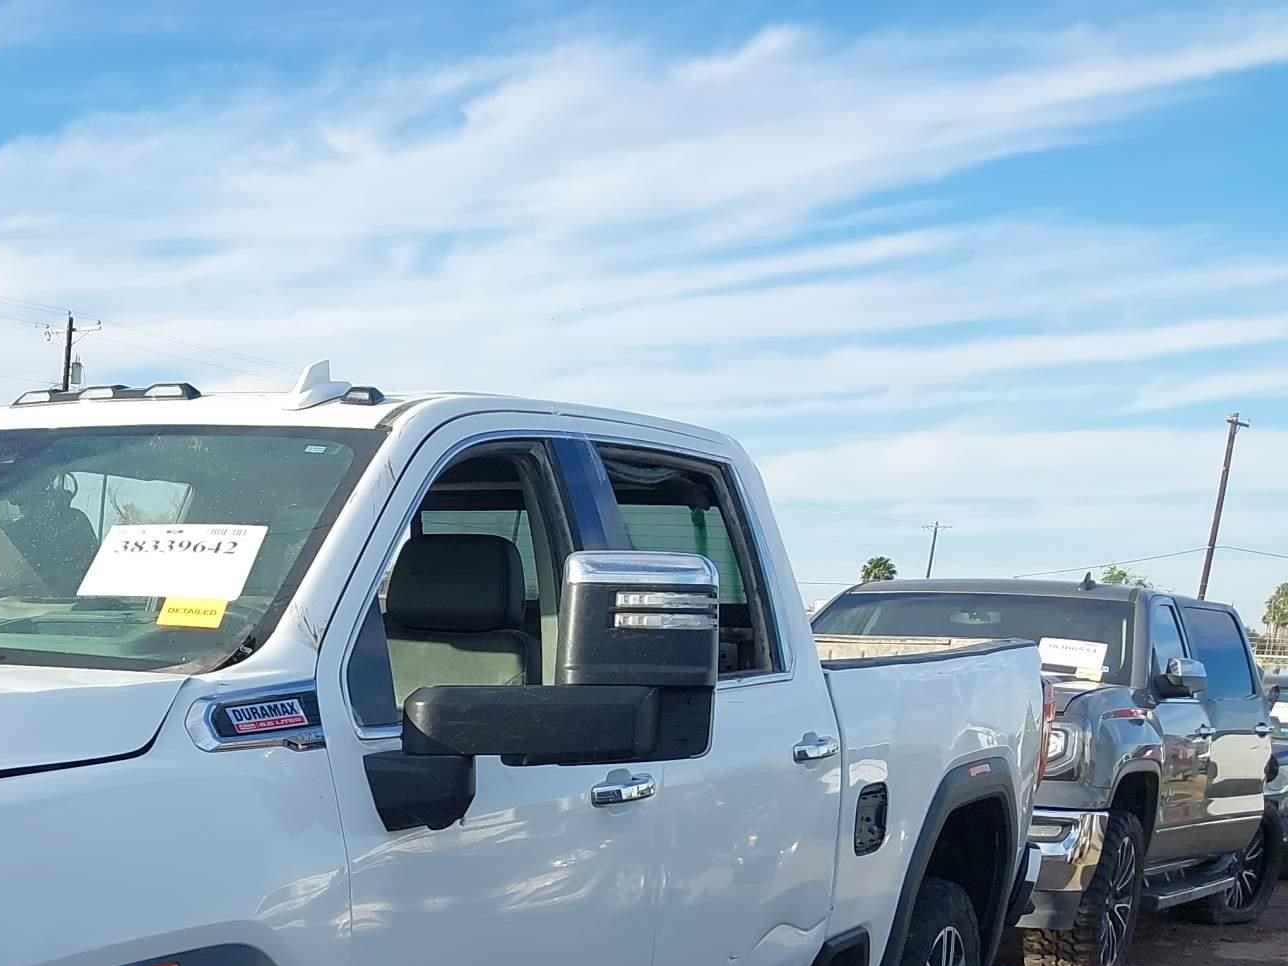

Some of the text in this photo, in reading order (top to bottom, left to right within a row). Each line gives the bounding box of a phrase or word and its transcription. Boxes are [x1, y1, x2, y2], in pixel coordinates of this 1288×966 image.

[114, 539, 239, 555] 38339642
[167, 607, 217, 616] DETAILED
[232, 701, 299, 722] DURAMAX
